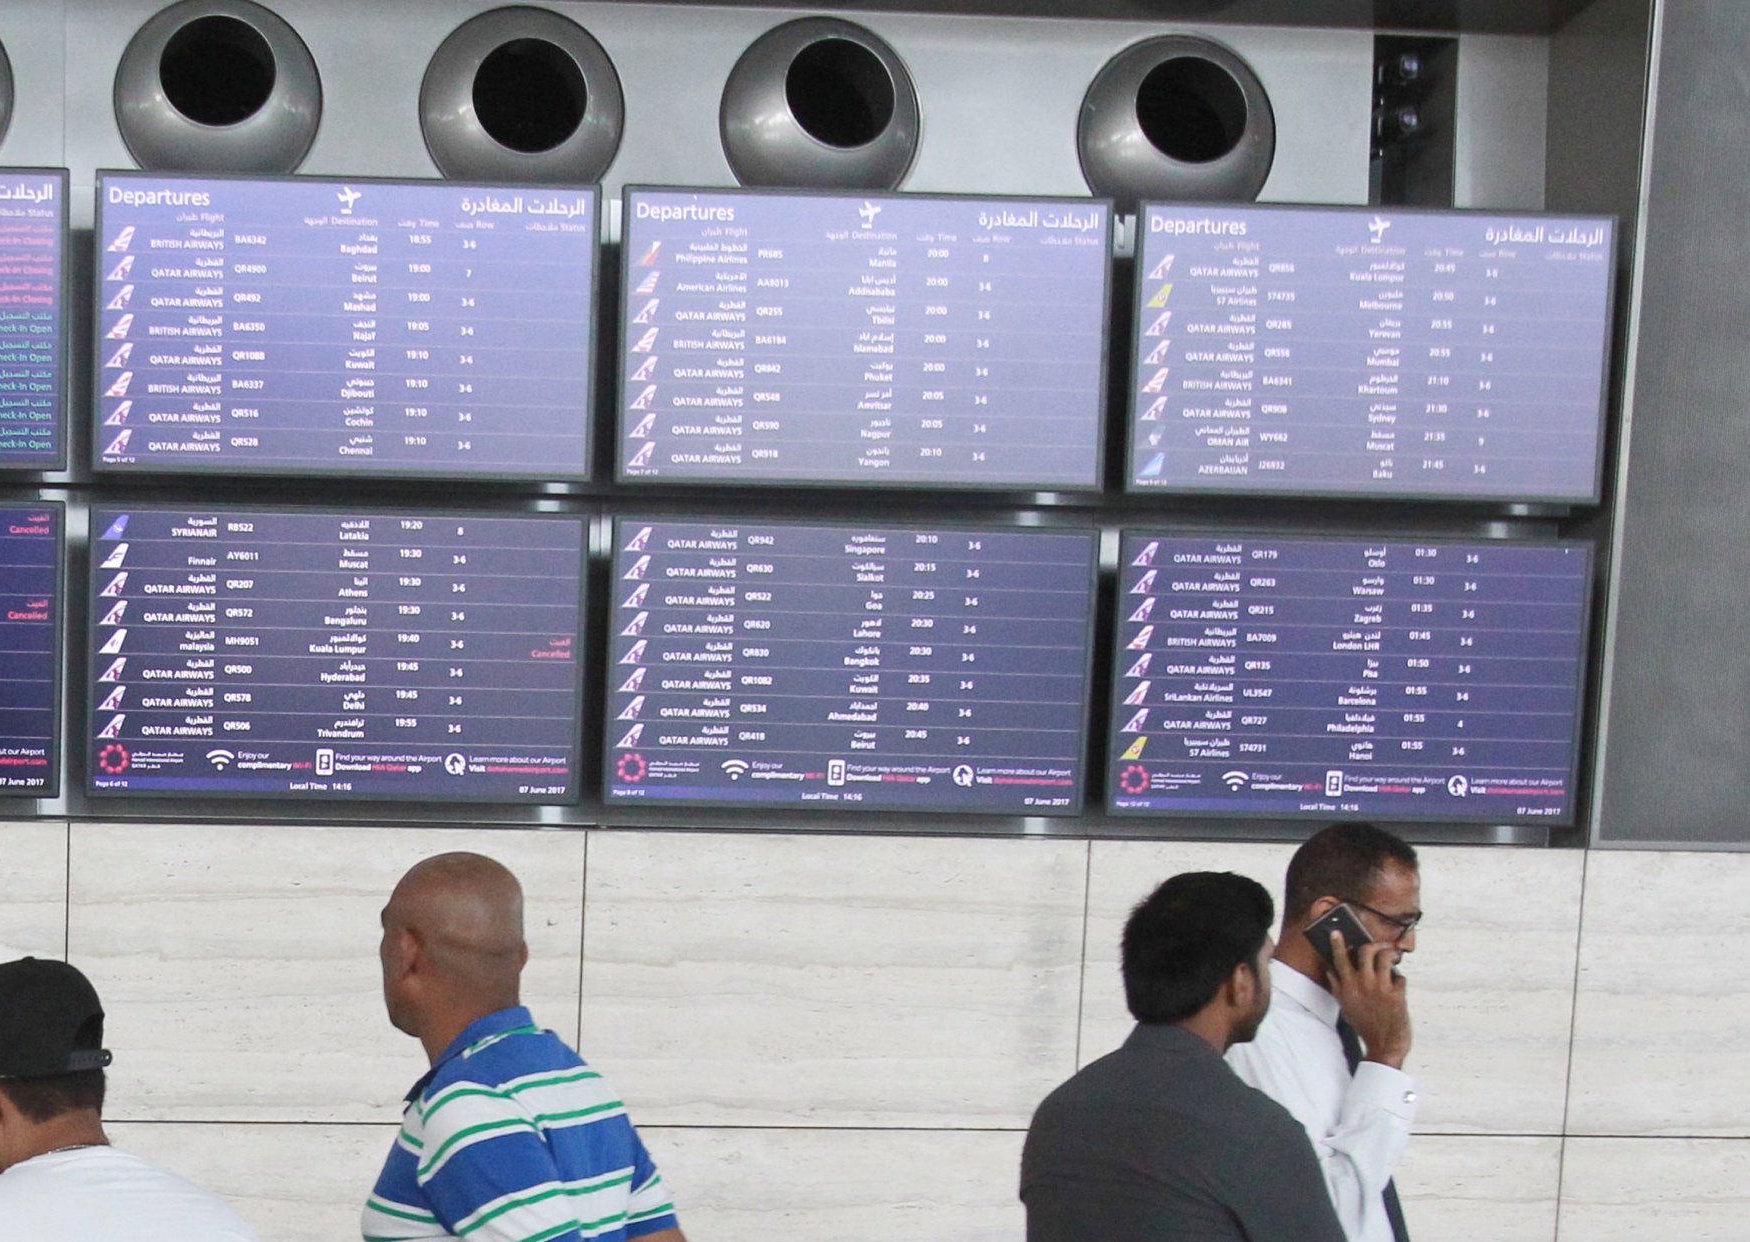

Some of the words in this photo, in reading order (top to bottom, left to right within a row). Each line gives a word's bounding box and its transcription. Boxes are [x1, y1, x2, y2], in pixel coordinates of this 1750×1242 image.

[108, 185, 211, 208] Departures
[461, 195, 524, 216] المغادرة
[526, 197, 586, 219] الرحلات
[636, 201, 735, 222] Departures
[978, 209, 1038, 231] المغادرة
[1042, 211, 1099, 232] الرحلات
[1151, 214, 1247, 236] Departures
[1485, 225, 1545, 245] المغادرة
[1548, 227, 1604, 247] الرحلات
[28, 410, 52, 421] Open
[28, 439, 52, 450] Open
[400, 520, 423, 530] 19:20
[171, 527, 218, 537] SYRIANAIR
[339, 531, 370, 541] Latakia
[915, 534, 939, 544] 20:10
[399, 548, 423, 558] 19:30
[844, 544, 886, 555] Singapore
[187, 556, 217, 566] Finnair
[338, 559, 369, 569] Muscat
[1367, 558, 1386, 568] Oslo
[338, 587, 368, 597] Athens
[1352, 585, 1385, 595] Warsaw
[865, 600, 883, 610] Goa
[7, 611, 48, 620] Cancelled
[324, 615, 367, 627] Bengaluru
[1353, 613, 1382, 625] Zagreb
[852, 628, 882, 638] Lahore
[179, 641, 215, 653] malaysia
[308, 644, 334, 653] Kuala
[334, 644, 367, 655] Lumpur
[1332, 641, 1363, 650] London
[843, 656, 880, 667] Bangkok
[320, 672, 366, 683] Hyderabad
[849, 684, 879, 694] Kuwait
[342, 698, 365, 710] Delhi
[1338, 695, 1377, 706] Barcelona
[827, 711, 878, 722] Ahmedabad
[141, 725, 172, 736] QATAR
[172, 726, 214, 736] AIRWAYS
[316, 728, 365, 738] Trivandrum
[1326, 723, 1375, 734] Philadelphia
[850, 740, 876, 749] Beirut
[7, 777, 26, 786] June
[26, 777, 45, 786] 2017
